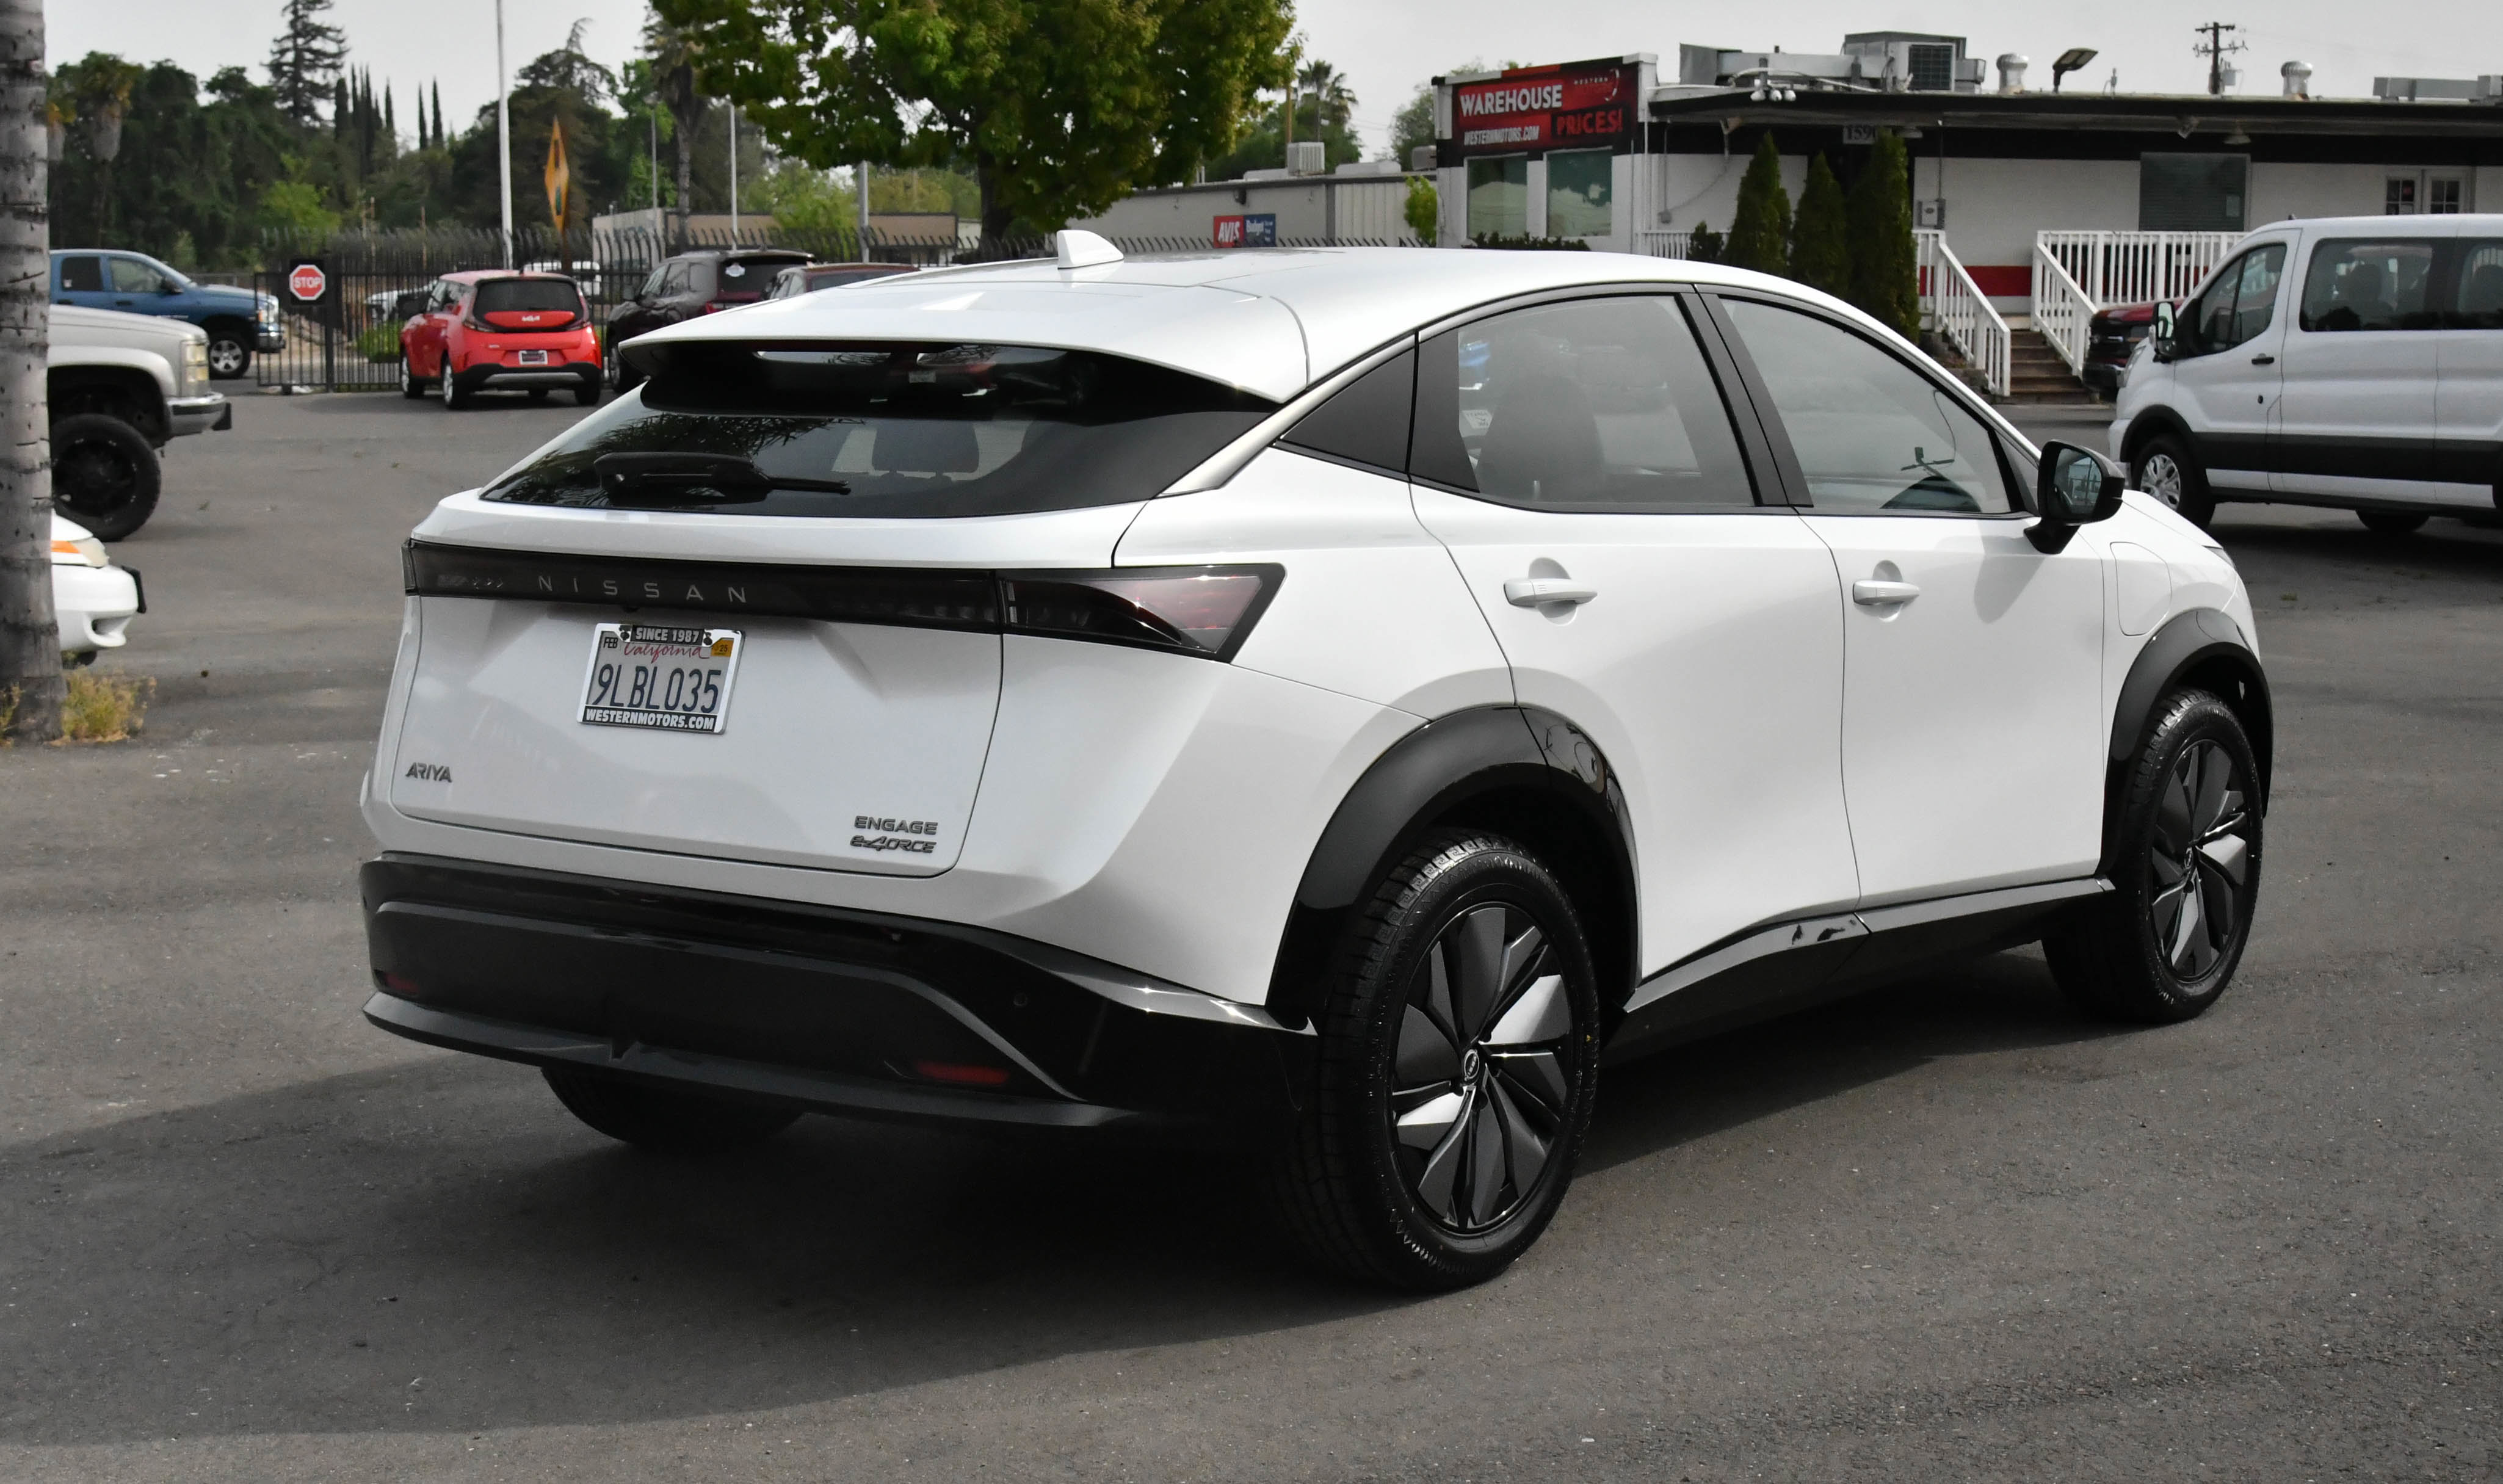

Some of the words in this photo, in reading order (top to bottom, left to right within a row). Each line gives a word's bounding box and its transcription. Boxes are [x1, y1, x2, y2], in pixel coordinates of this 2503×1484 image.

[1460, 85, 1562, 117] WAREHOUSE
[1556, 109, 1623, 136] PRICES!
[1464, 126, 1540, 146] WESTERNMOTORS.COM
[1217, 220, 1241, 242] AVIS
[294, 277, 323, 288] STOP
[538, 574, 747, 604] NISSAN
[603, 637, 618, 649] FEB
[635, 628, 668, 641] SINCE
[672, 630, 700, 643] 1987
[623, 643, 710, 664] California
[719, 644, 728, 653] 25
[592, 664, 722, 713] 9LBL035
[585, 709, 715, 730] WESTERNMOTORS.COM
[405, 762, 452, 783] ARIYA
[855, 815, 938, 836] ENGAGE
